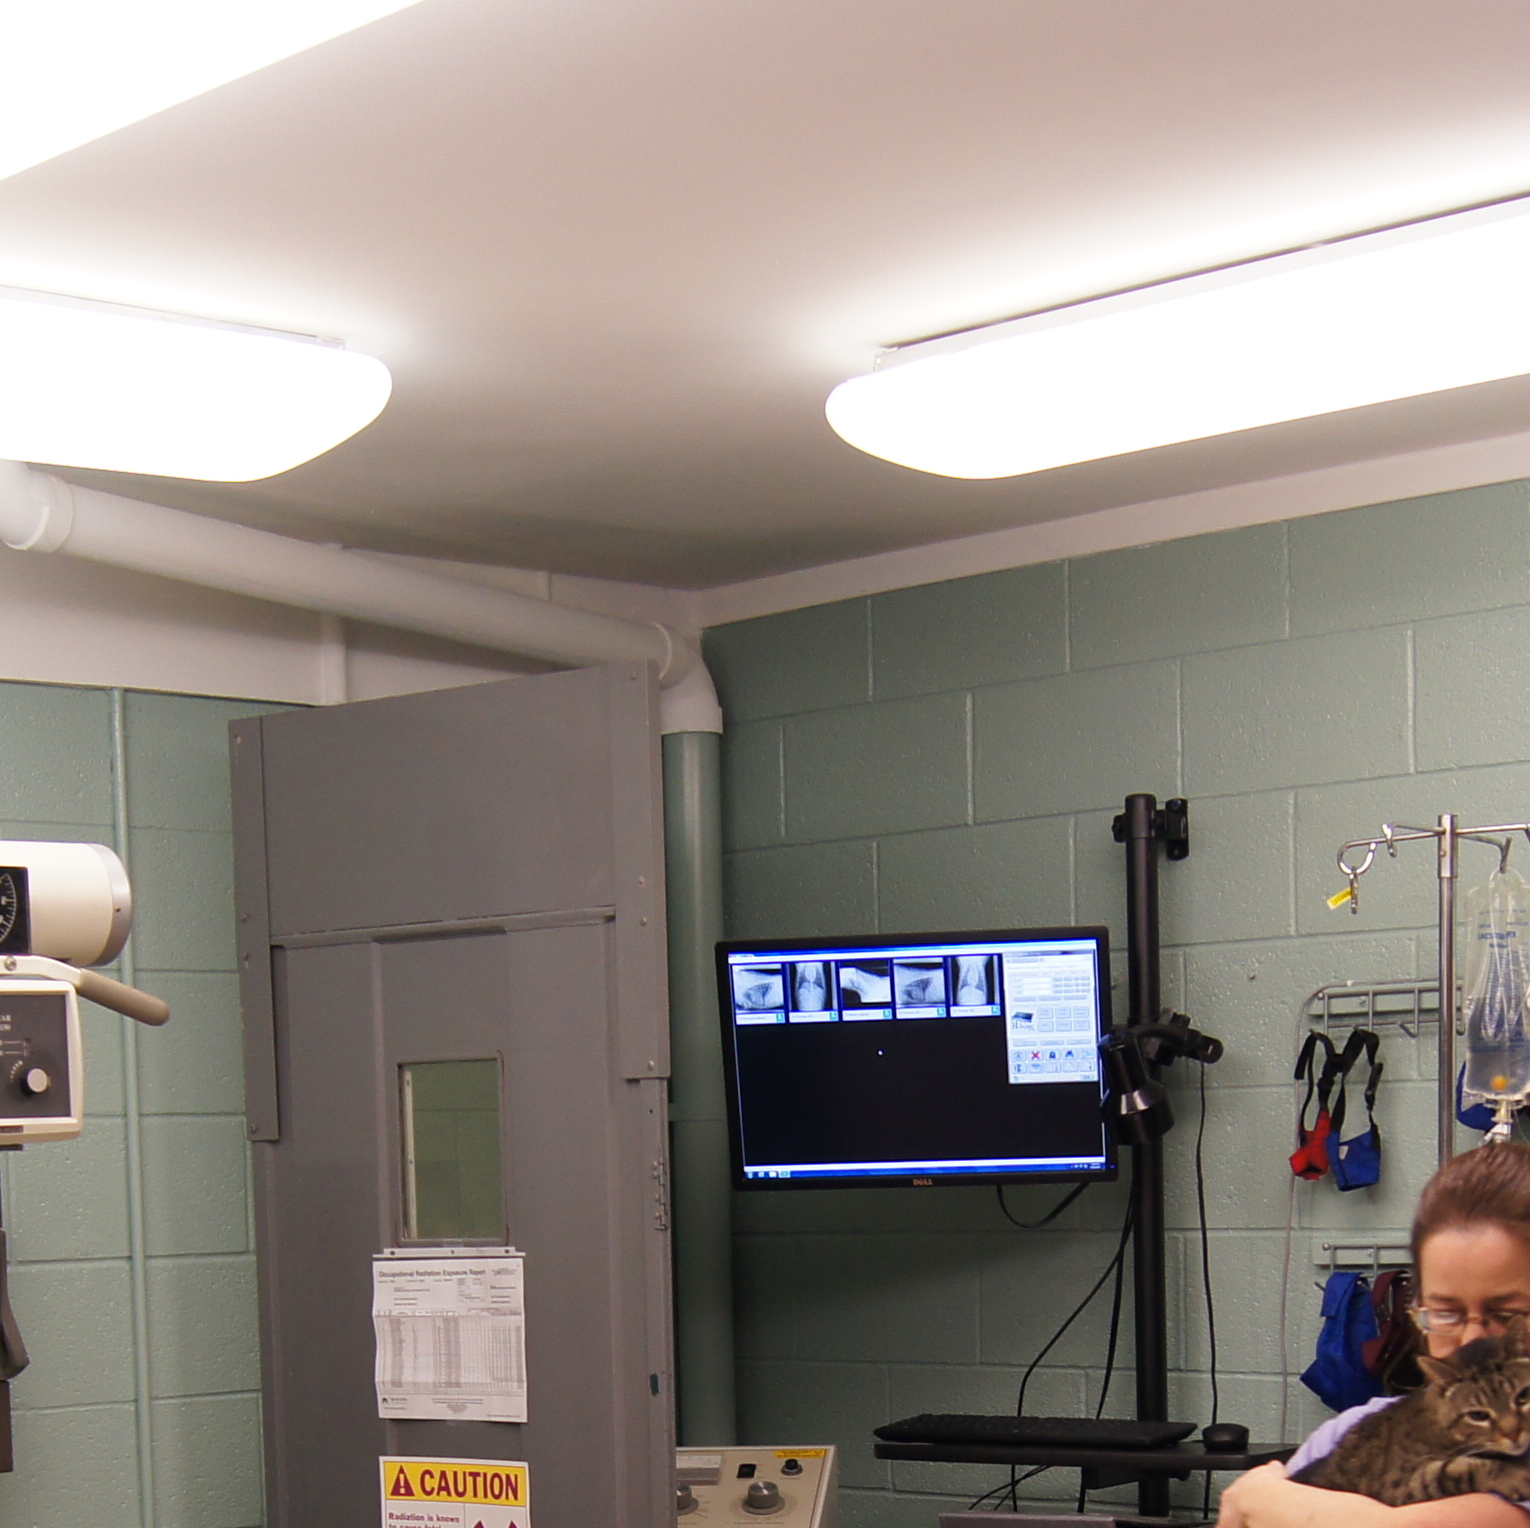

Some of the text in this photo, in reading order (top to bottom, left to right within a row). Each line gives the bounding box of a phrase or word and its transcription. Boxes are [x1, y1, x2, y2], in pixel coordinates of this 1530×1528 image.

[416, 1269, 441, 1277] Radiation
[443, 1269, 467, 1277] Exposure
[420, 1469, 519, 1501] CAUTION
[389, 1512, 460, 1523] Radiation is known
